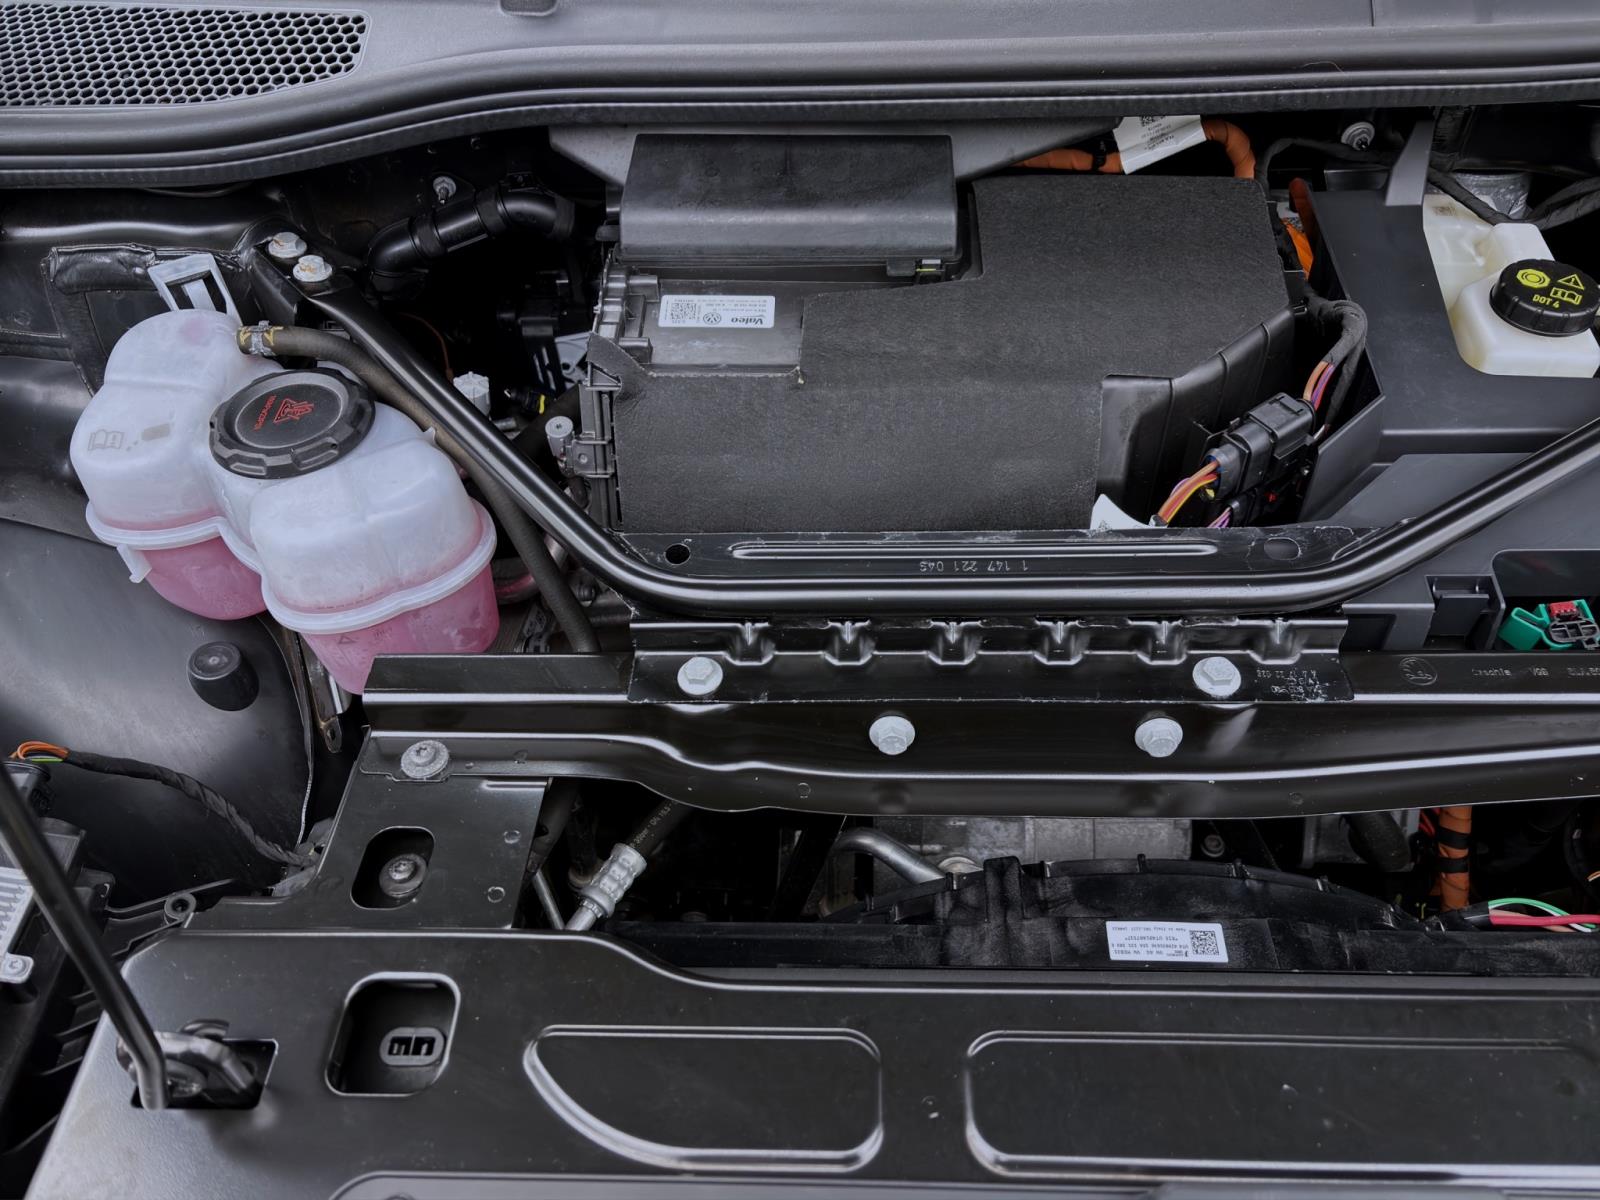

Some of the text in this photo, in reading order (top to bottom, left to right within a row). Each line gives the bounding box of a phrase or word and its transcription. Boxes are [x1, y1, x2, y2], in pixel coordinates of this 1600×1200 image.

[1532, 294, 1560, 309] DOT 4
[731, 316, 763, 325] Valeo
[953, 560, 979, 572] 221
[987, 560, 1011, 572] 147
[1022, 560, 1029, 571] 1
